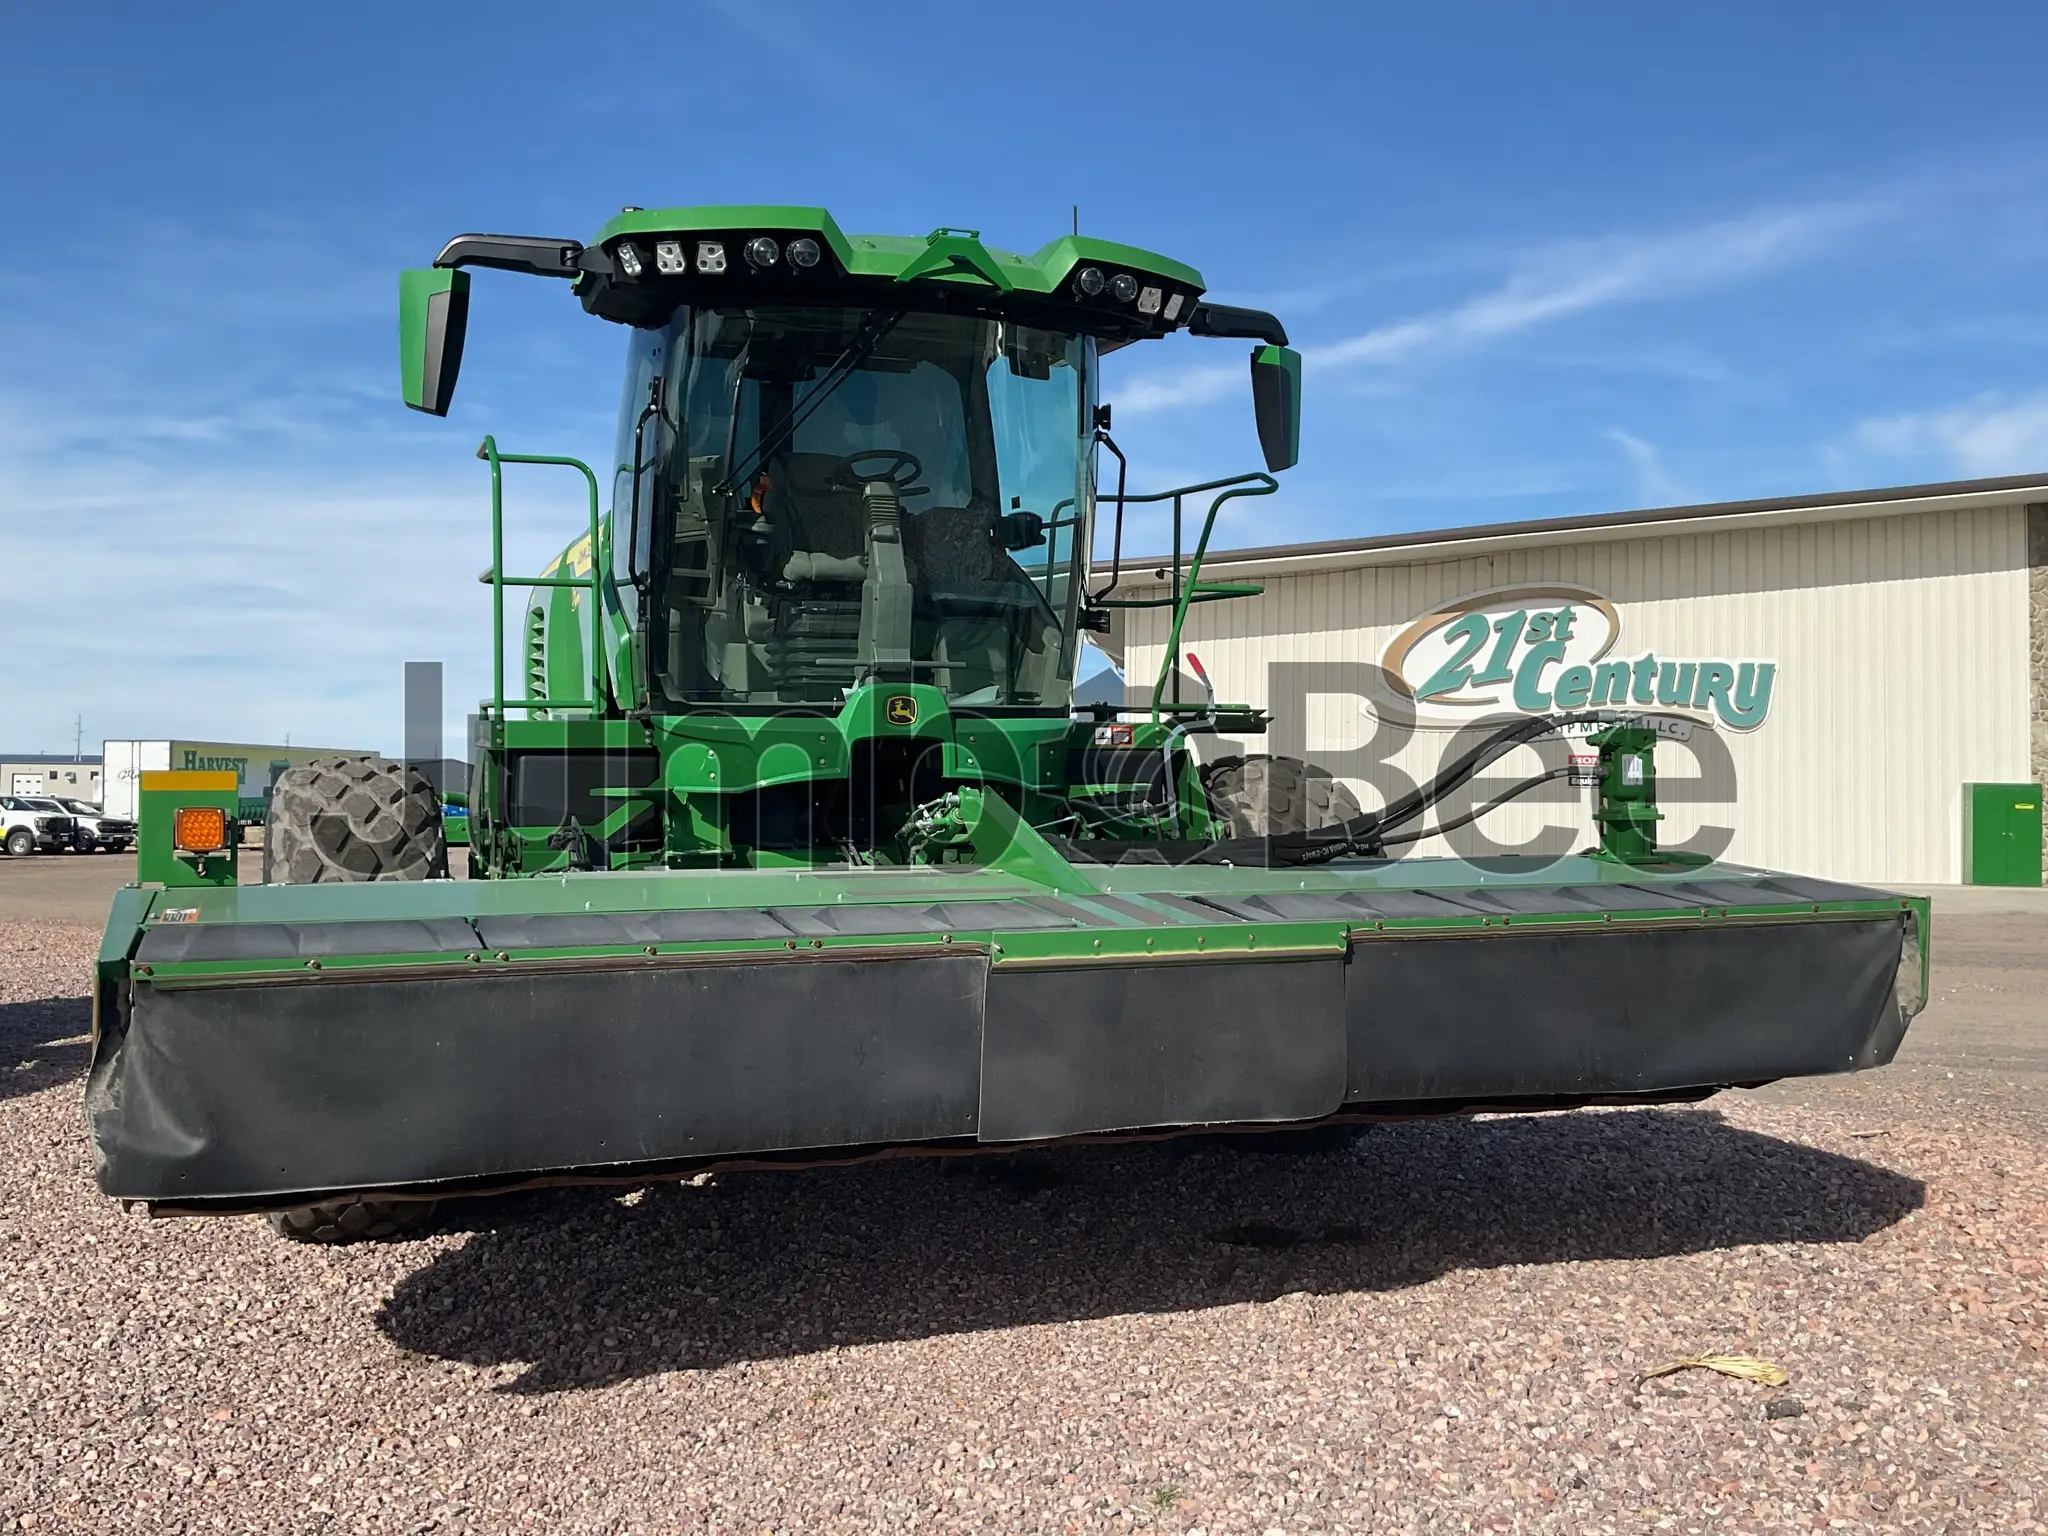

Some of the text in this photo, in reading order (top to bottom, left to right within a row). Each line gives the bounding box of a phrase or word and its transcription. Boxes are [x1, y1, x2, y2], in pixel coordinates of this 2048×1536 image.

[1415, 605, 1577, 701] 21st
[183, 750, 248, 772] HARVEST
[1571, 756, 1600, 765] HON
